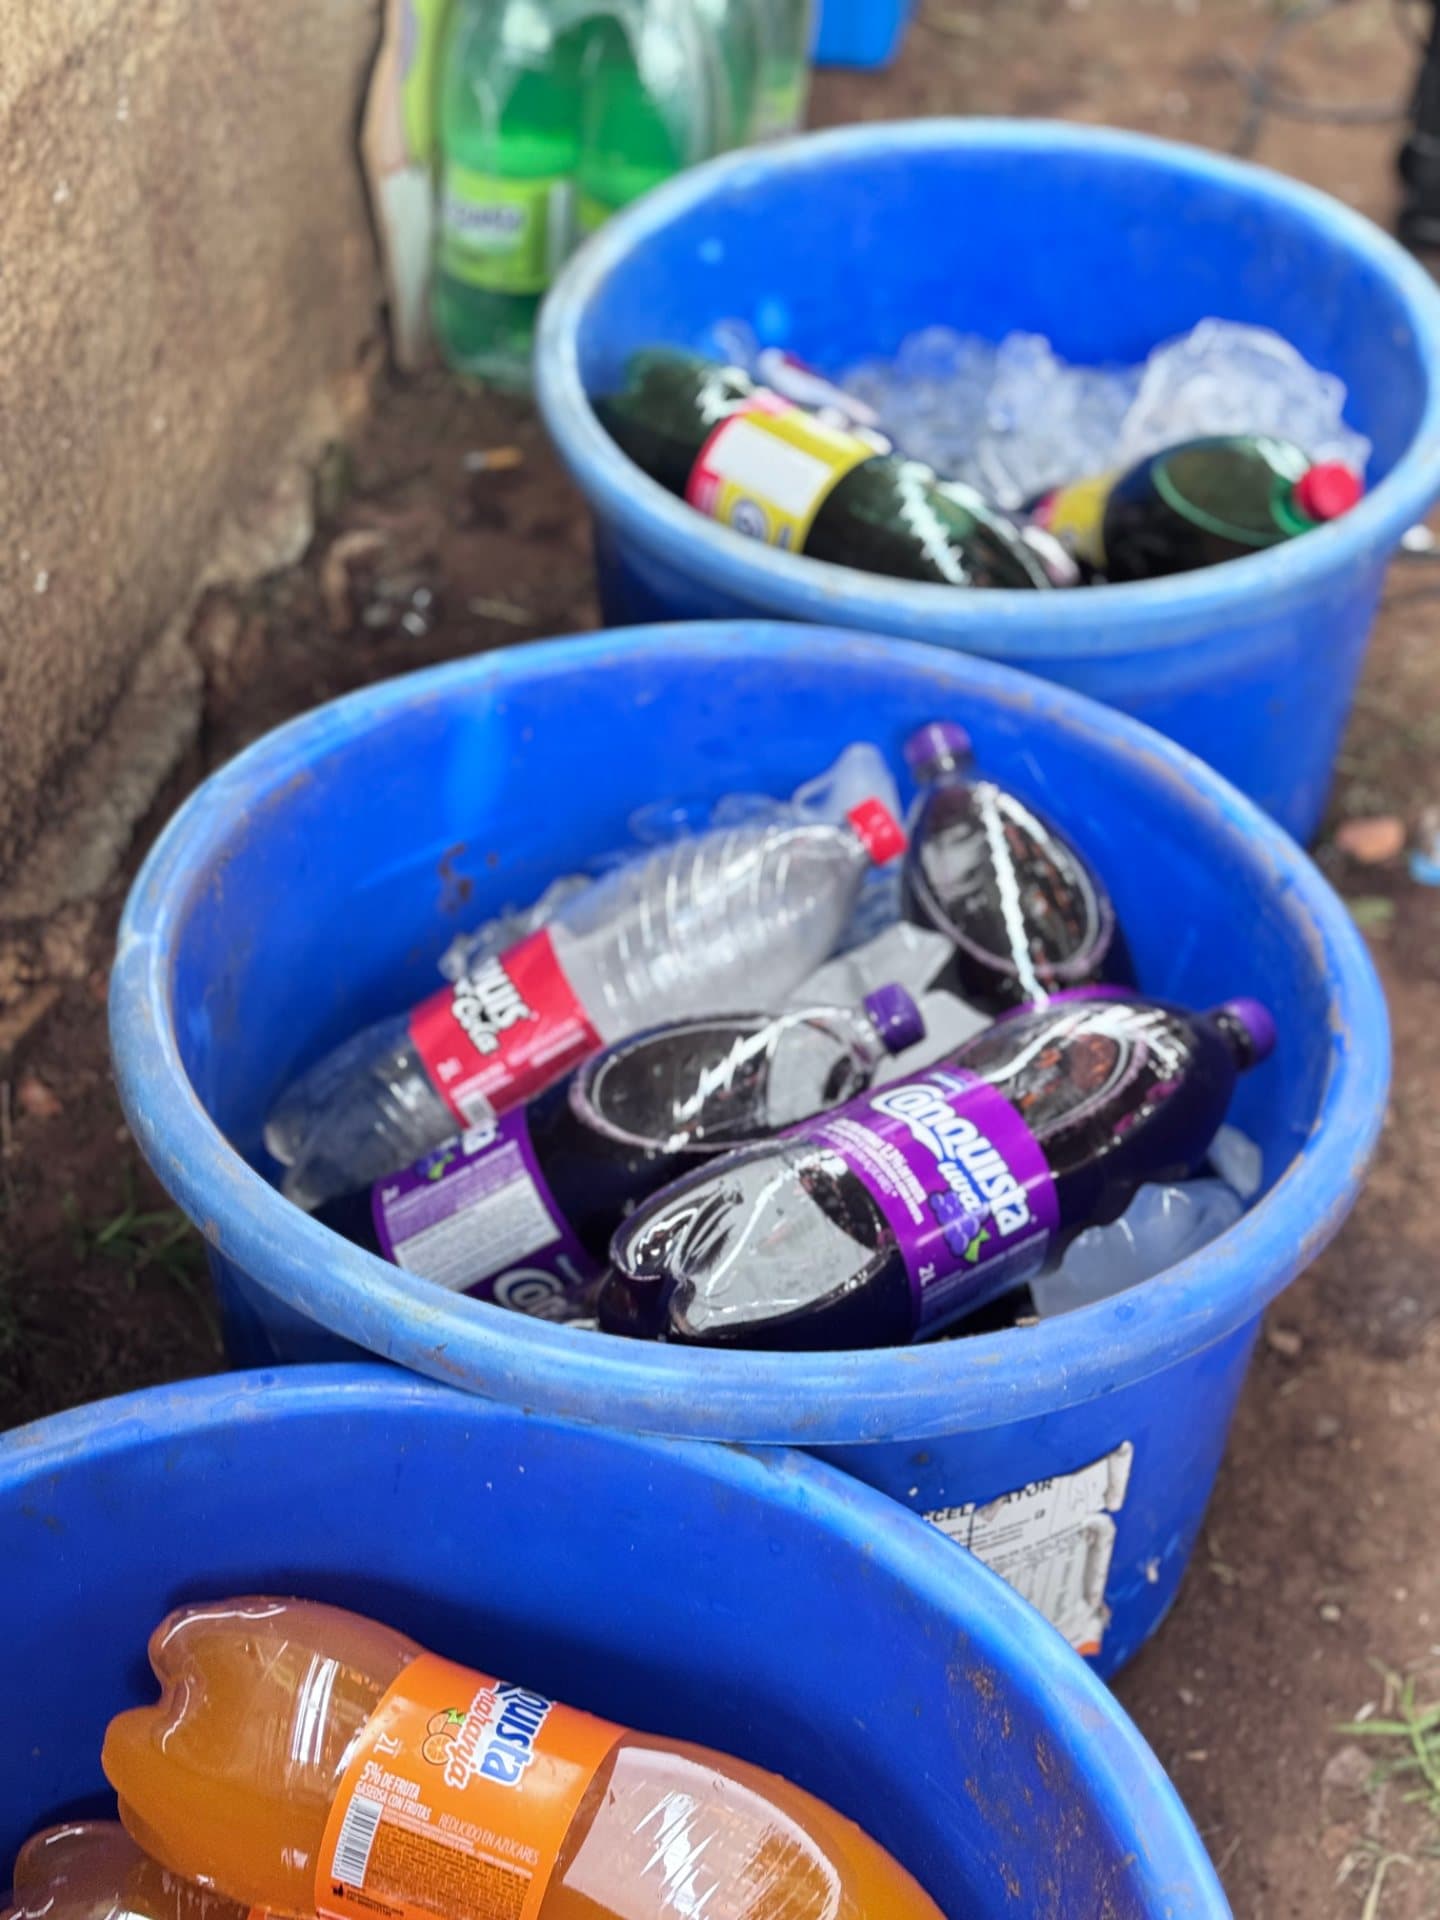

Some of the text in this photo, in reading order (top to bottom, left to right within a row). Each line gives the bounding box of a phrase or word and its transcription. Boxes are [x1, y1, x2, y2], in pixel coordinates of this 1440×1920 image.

[937, 1161, 983, 1216] uva
[373, 1731, 400, 1758] 2L
[445, 1688, 498, 1789] naranja
[355, 1781, 432, 1821] GASEOSA CON FRUTAS
[360, 1761, 421, 1801] 5% DE FRUTA
[440, 1814, 482, 1838] REDUCIDO
